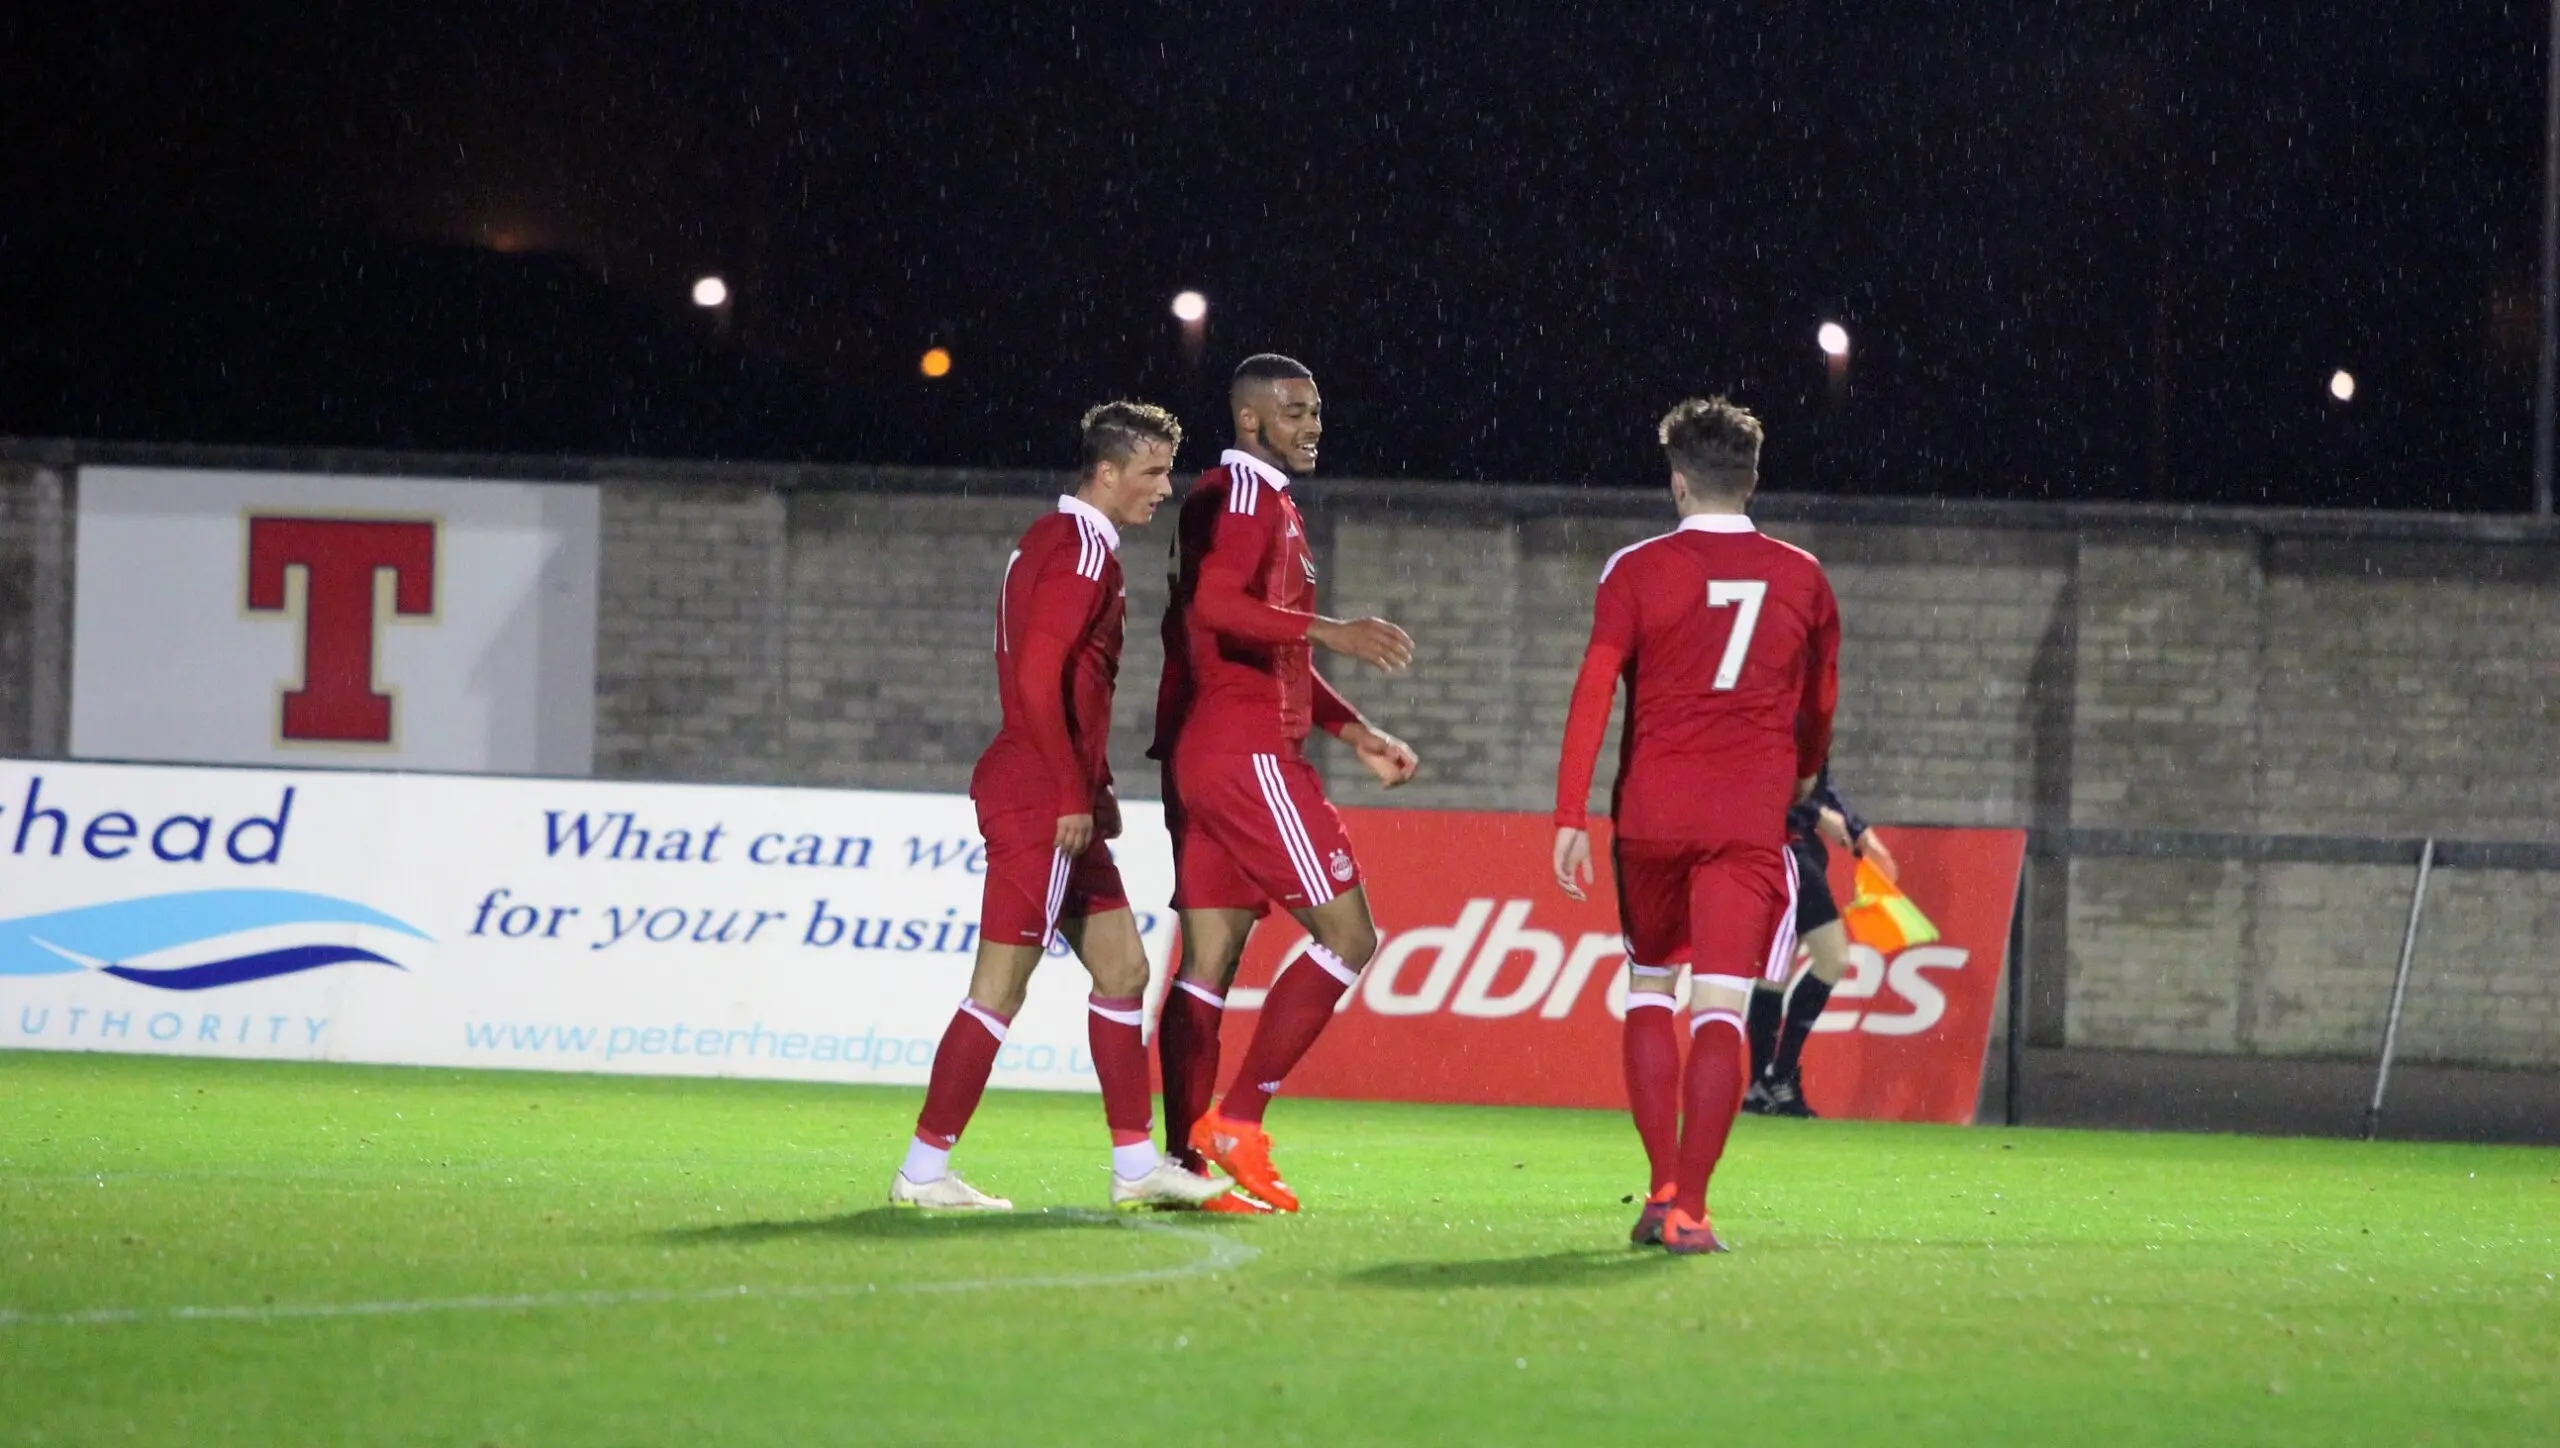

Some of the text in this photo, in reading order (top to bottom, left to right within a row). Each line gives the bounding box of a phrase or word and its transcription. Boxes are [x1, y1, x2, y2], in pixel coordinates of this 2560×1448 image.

[241, 509, 443, 750] T
[1706, 579, 1768, 690] 7
[0, 776, 296, 865] head
[543, 808, 727, 863] What
[747, 830, 874, 868] can
[466, 887, 580, 939] for
[590, 902, 787, 951] your
